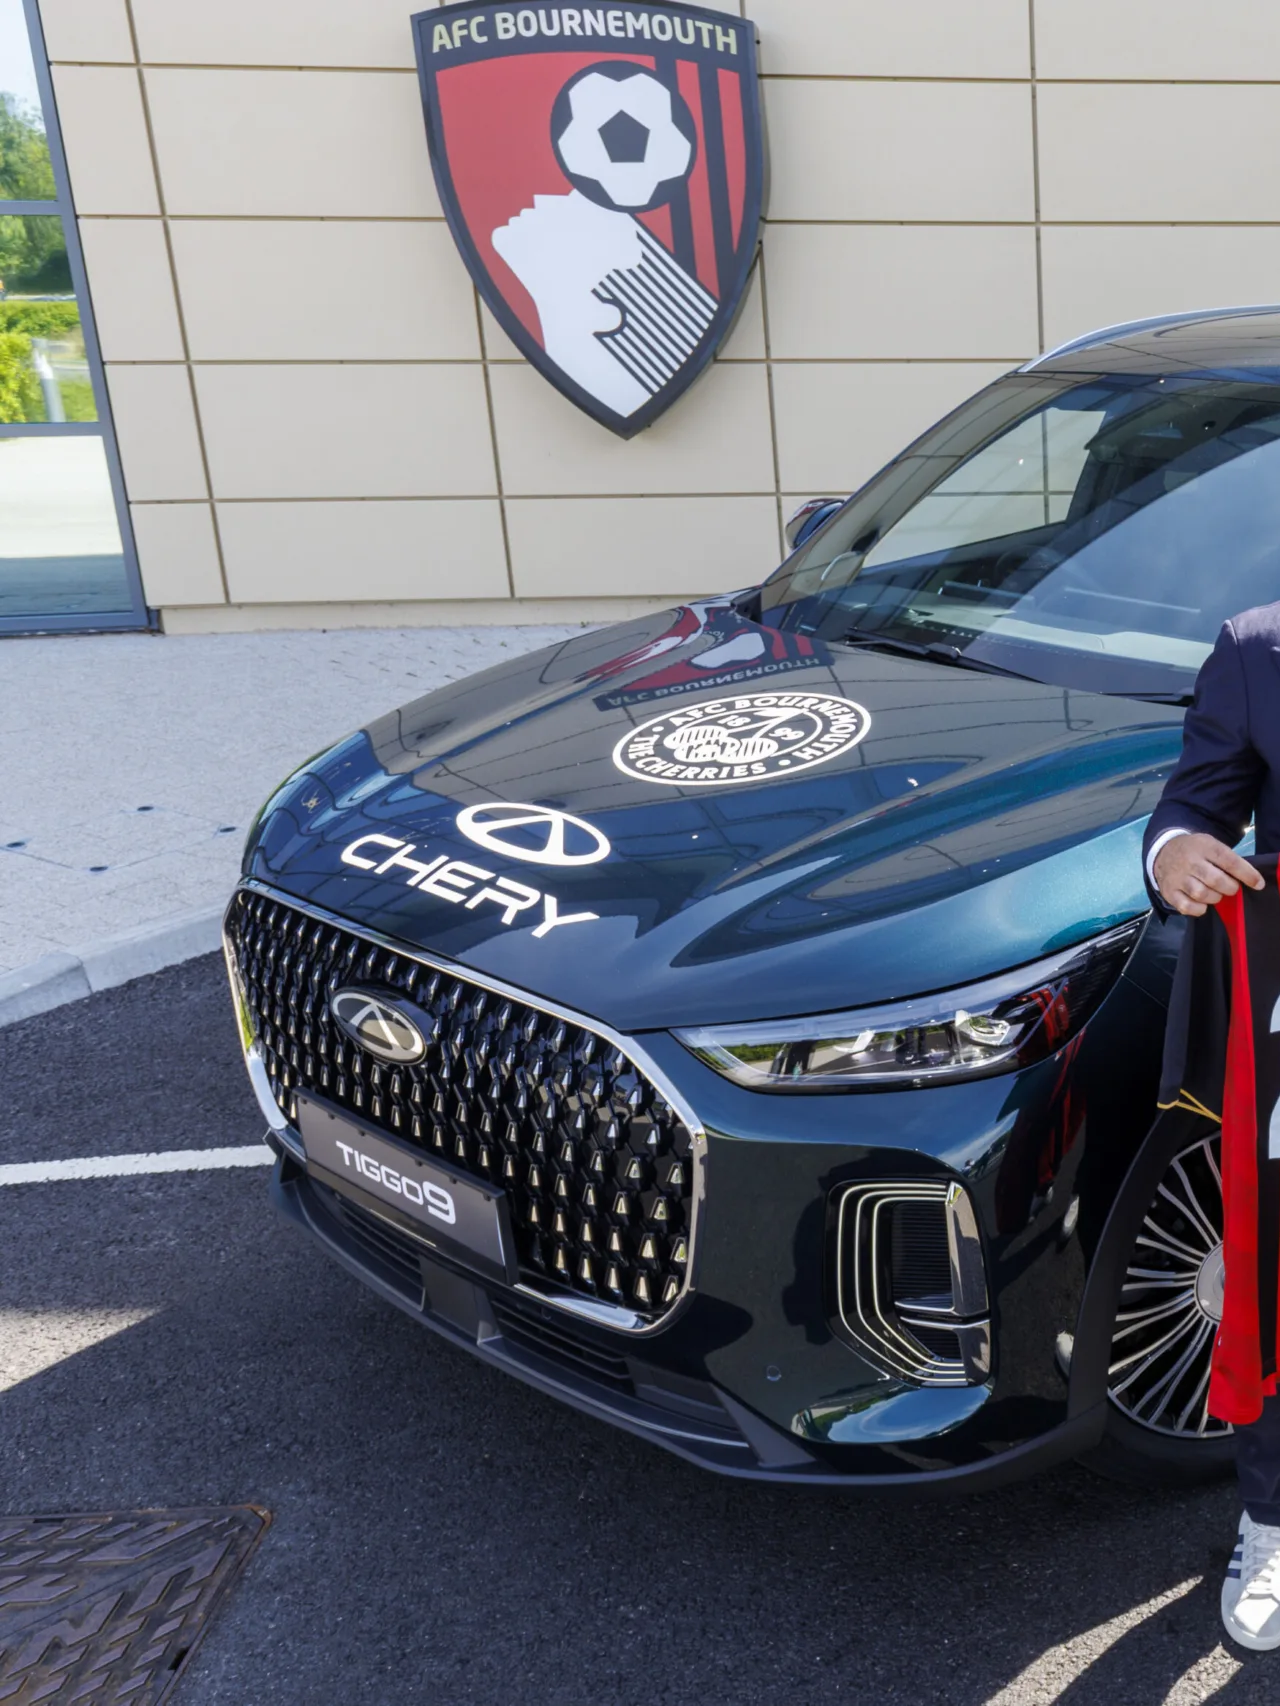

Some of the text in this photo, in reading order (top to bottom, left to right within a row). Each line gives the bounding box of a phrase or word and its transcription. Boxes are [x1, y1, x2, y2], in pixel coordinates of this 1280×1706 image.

[432, 8, 738, 55] AFC BOURNEMOUTH
[669, 696, 858, 762] AFC BOURNEMOUTH
[717, 715, 751, 727] 18
[628, 734, 767, 779] THE CHERRIES
[341, 833, 600, 939] CHERY
